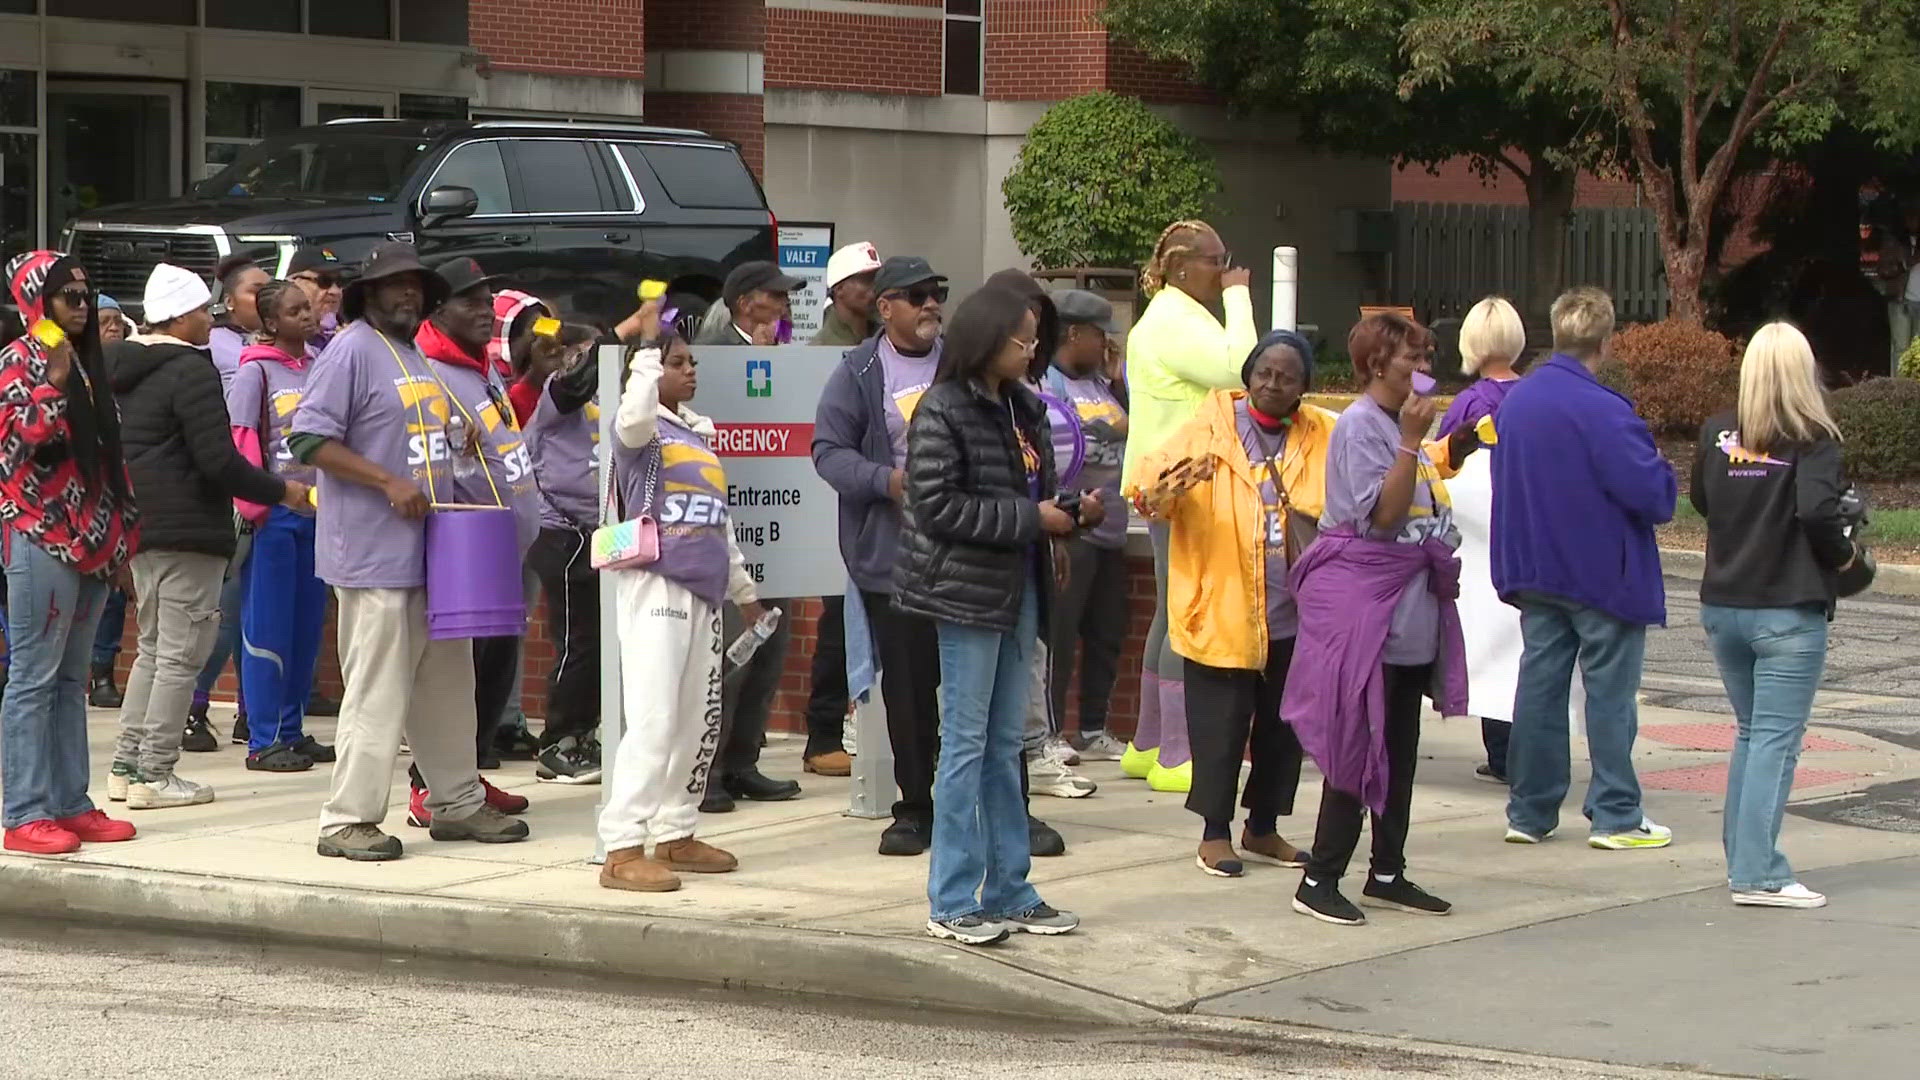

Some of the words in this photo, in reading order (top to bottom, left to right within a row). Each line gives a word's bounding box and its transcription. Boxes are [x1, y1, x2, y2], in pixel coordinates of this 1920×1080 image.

[785, 250, 818, 264] VALET
[709, 428, 790, 452] ERGENCY
[727, 485, 801, 506] Entrance
[734, 521, 764, 546] king
[769, 521, 780, 542] B
